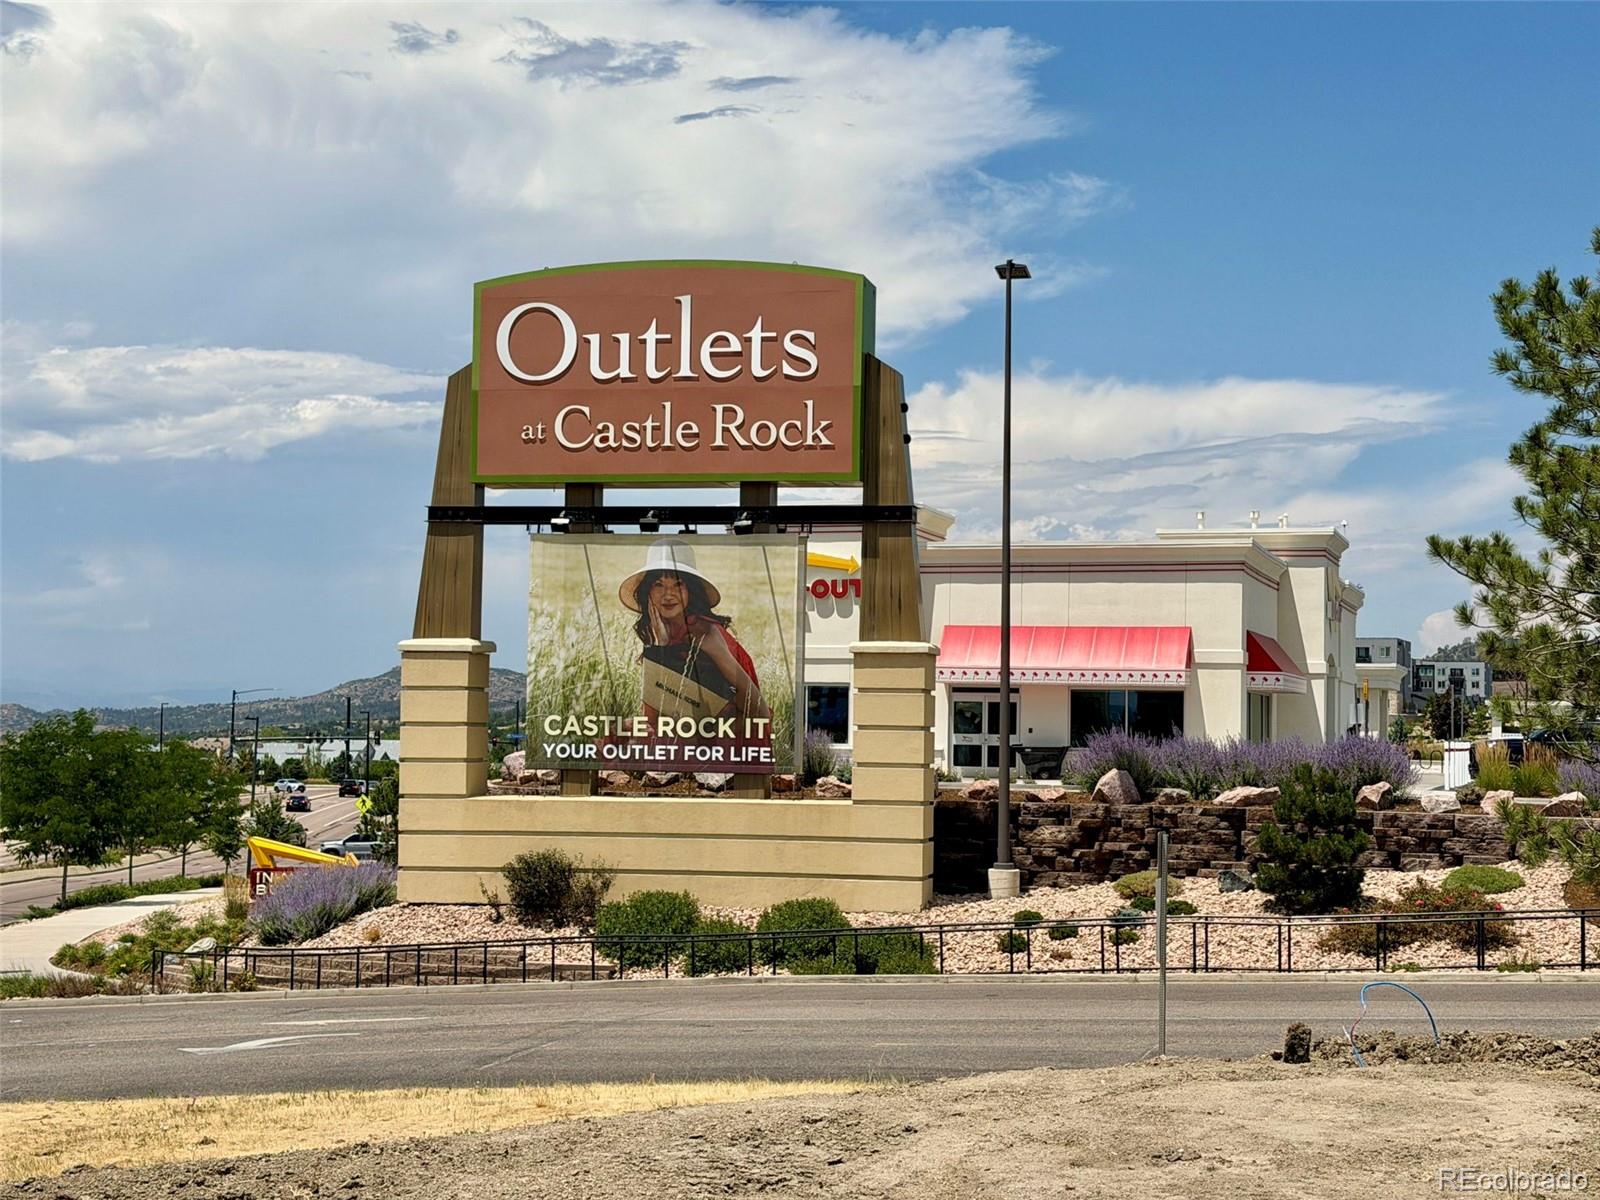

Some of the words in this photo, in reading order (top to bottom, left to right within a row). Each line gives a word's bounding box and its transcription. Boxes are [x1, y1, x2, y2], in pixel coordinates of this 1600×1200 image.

[496, 294, 819, 382] Outlets
[521, 421, 546, 440] at
[554, 401, 699, 449] Castle
[710, 400, 835, 448] Rock
[543, 714, 649, 737] CASTLE
[657, 716, 737, 739] ROCK
[744, 717, 776, 740] IT.
[542, 743, 597, 759] YOUR
[602, 743, 679, 761] OUTLET
[684, 745, 724, 761] FOR
[730, 746, 776, 763] LIFE.
